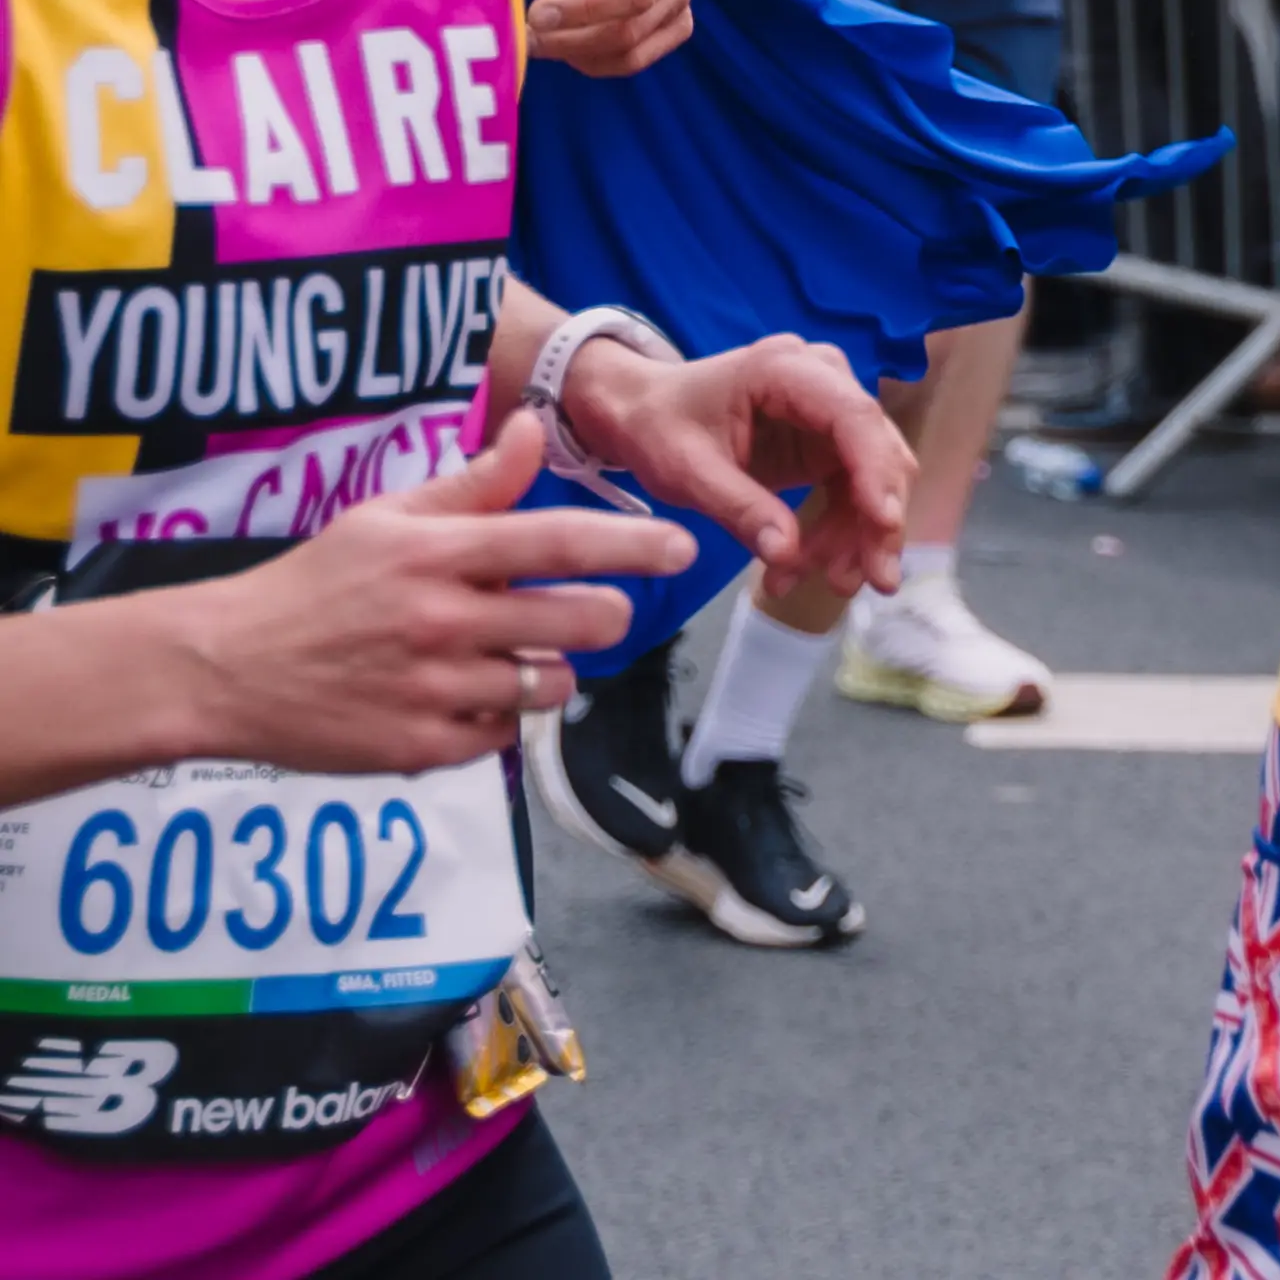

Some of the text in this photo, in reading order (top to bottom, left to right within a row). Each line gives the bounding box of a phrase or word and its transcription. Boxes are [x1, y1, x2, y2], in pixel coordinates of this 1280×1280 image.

[65, 23, 509, 208] CLAIRE
[57, 274, 347, 420] YOUNG
[236, 411, 468, 538] CANC
[58, 797, 428, 956] 60302
[67, 983, 131, 1003] MEDAL
[171, 1081, 406, 1133] new balan
